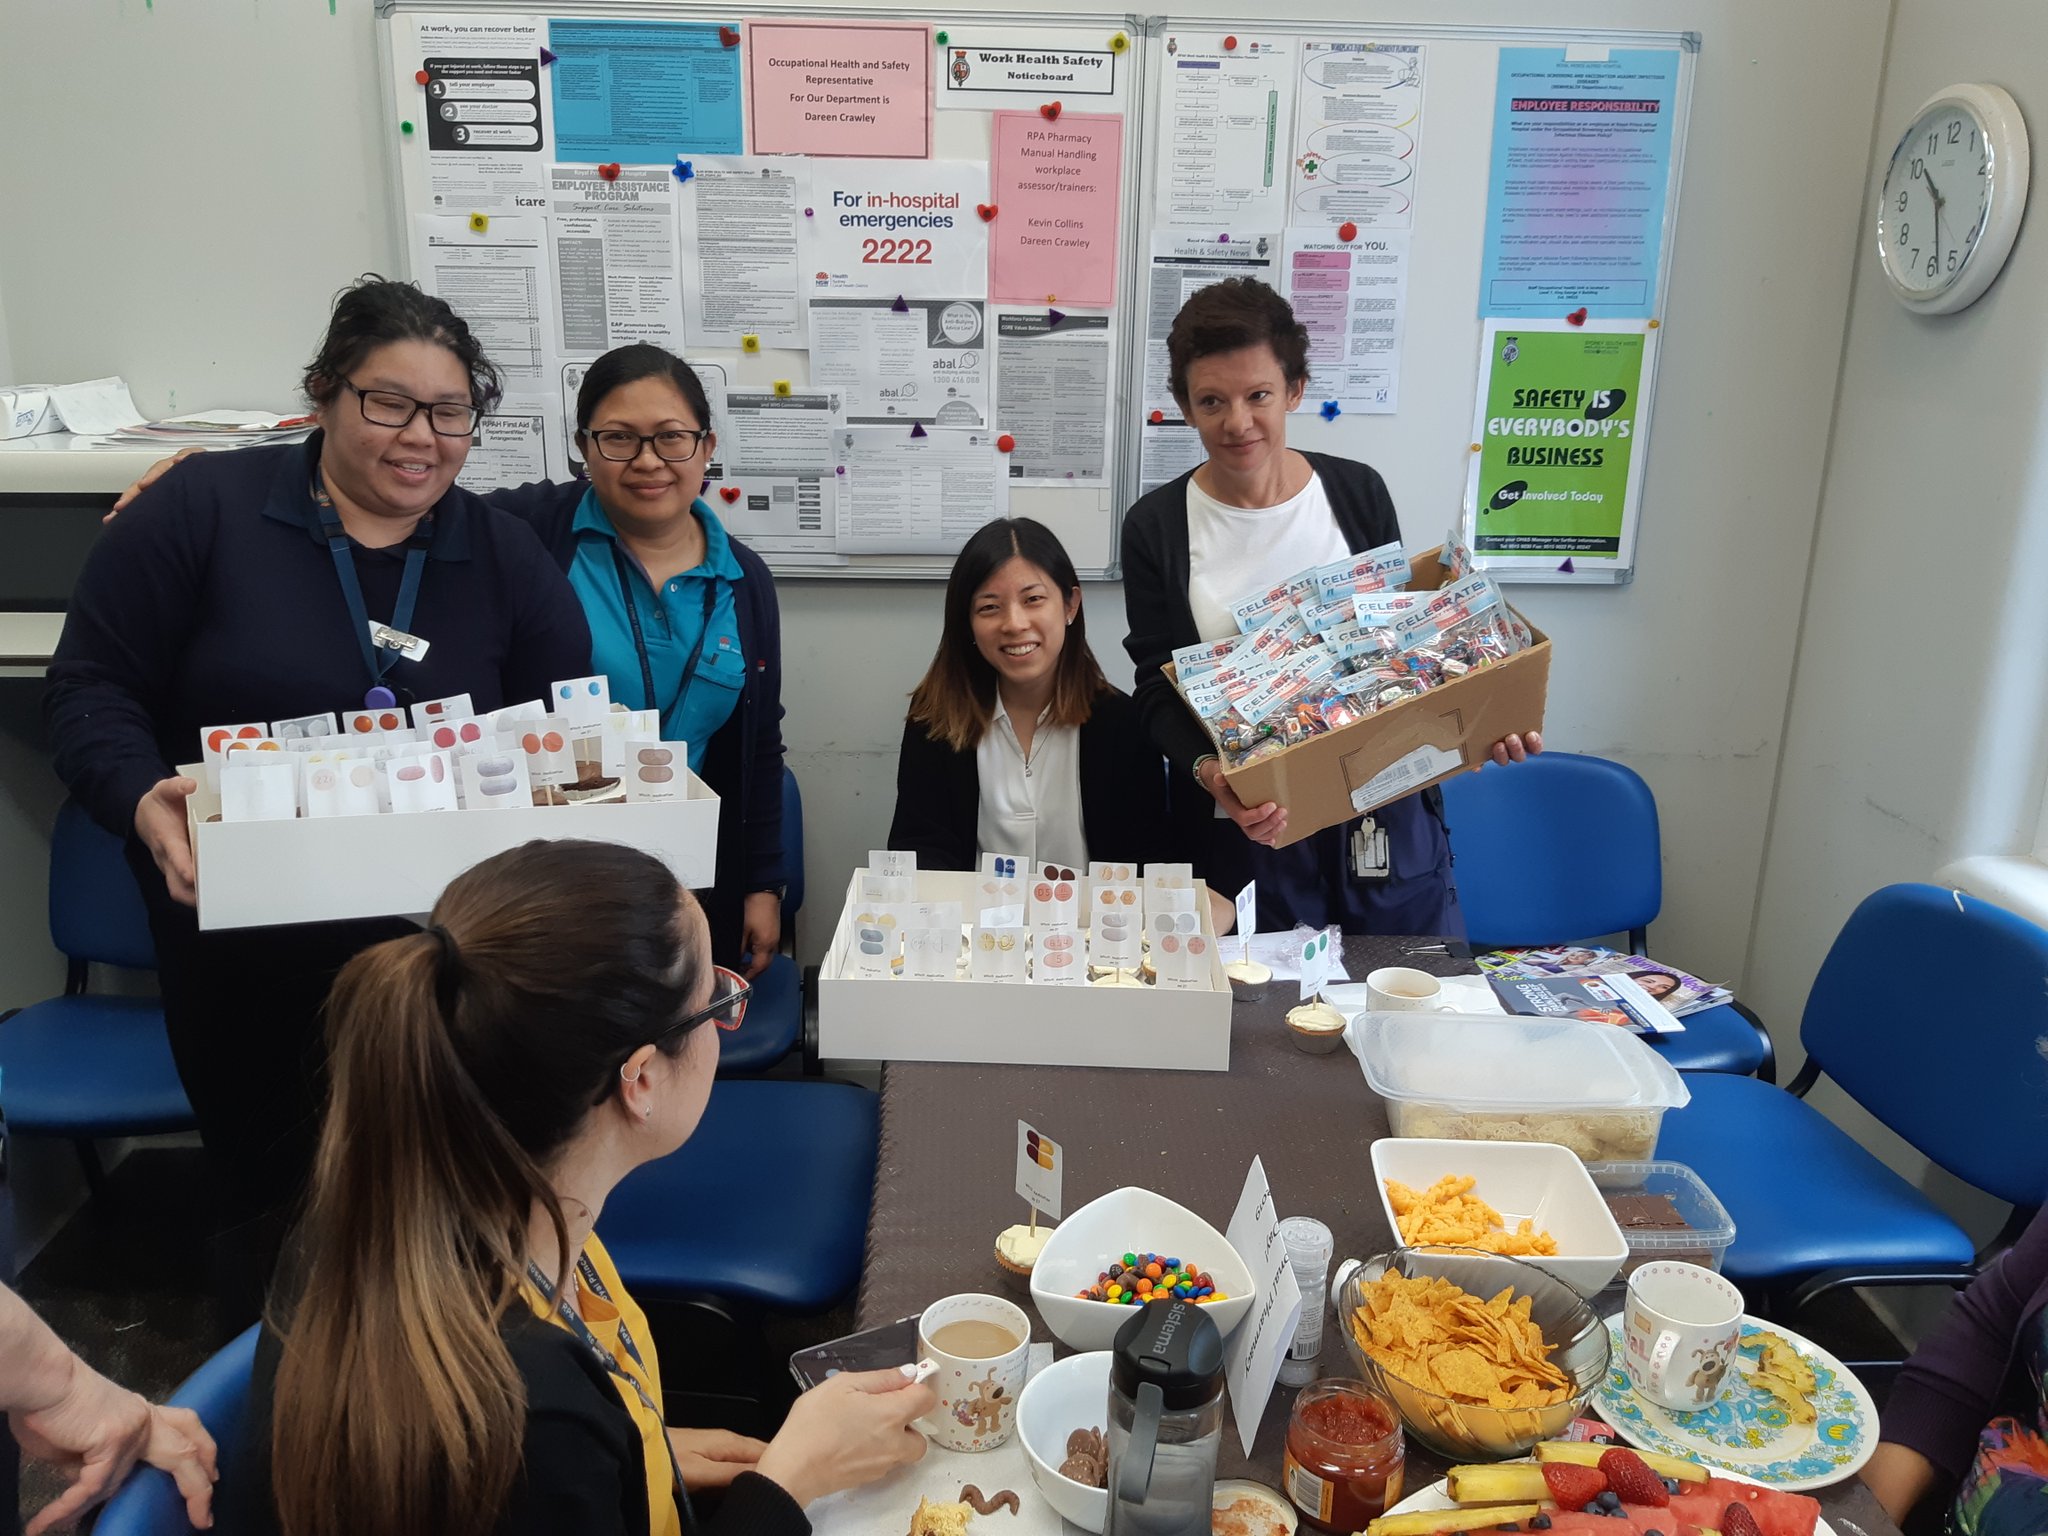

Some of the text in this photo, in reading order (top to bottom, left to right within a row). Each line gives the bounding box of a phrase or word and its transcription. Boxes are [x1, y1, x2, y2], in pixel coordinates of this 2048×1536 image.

[431, 25, 453, 33] work,
[768, 57, 910, 72] Occupational Health and Safety
[979, 53, 1103, 69] Work Health Safety
[805, 75, 874, 86] Representative
[1007, 72, 1074, 81] Noticeboard
[433, 84, 442, 94] 1
[790, 94, 890, 105] For Our Department is
[1512, 100, 1660, 112] EMPLOYEE RESPONSIBILITY
[445, 107, 454, 117] 2
[805, 112, 876, 124] Dareen Crawley
[456, 128, 466, 141] 3
[1027, 131, 1092, 145] RPA Pharmacy
[1947, 121, 1961, 144] 12
[1928, 133, 1939, 155] 11
[1969, 130, 1975, 152] 1
[1020, 147, 1097, 161] Manual Handling
[1035, 166, 1082, 177] workplace
[1910, 159, 1924, 180] 10
[552, 181, 670, 193] EMPLOYEE ASSISTANCE
[1018, 181, 1097, 193] assessor/trainers:
[515, 195, 546, 206] icare
[584, 191, 640, 201] PROGRAM
[833, 191, 959, 212] For in-hospital
[1898, 191, 1908, 213] 9
[839, 212, 954, 231] emergencies
[1028, 218, 1084, 229] Kevin Collins
[1900, 223, 1910, 246] 8
[1020, 236, 1090, 250] Dareen Crawley
[1364, 242, 1389, 251] YOU.
[862, 238, 933, 264] 2222
[1174, 248, 1198, 256] Health
[1206, 248, 1228, 258] Safety
[1911, 248, 1920, 270] 7
[1947, 250, 1958, 272] 5
[1927, 256, 1938, 278] 6
[932, 358, 956, 369] abal
[879, 388, 899, 398] abal
[1513, 388, 1611, 409] SAFETY IS
[1487, 416, 1631, 438] EVERYBODY'S
[1507, 446, 1604, 466] BUSINESS
[1498, 489, 1604, 504] Get Involved Today
[1321, 558, 1401, 586] CELEBRATE
[1237, 576, 1312, 617] CELEBRATE
[1395, 582, 1481, 631] CELEBRATE
[1242, 654, 1316, 712] CELEBRATE
[888, 856, 897, 864] 10
[1055, 954, 1062, 964] 5
[1515, 983, 1552, 1013] STRONG
[1152, 1302, 1187, 1355] sistema
[1245, 1295, 1275, 1378] Pharmacy
